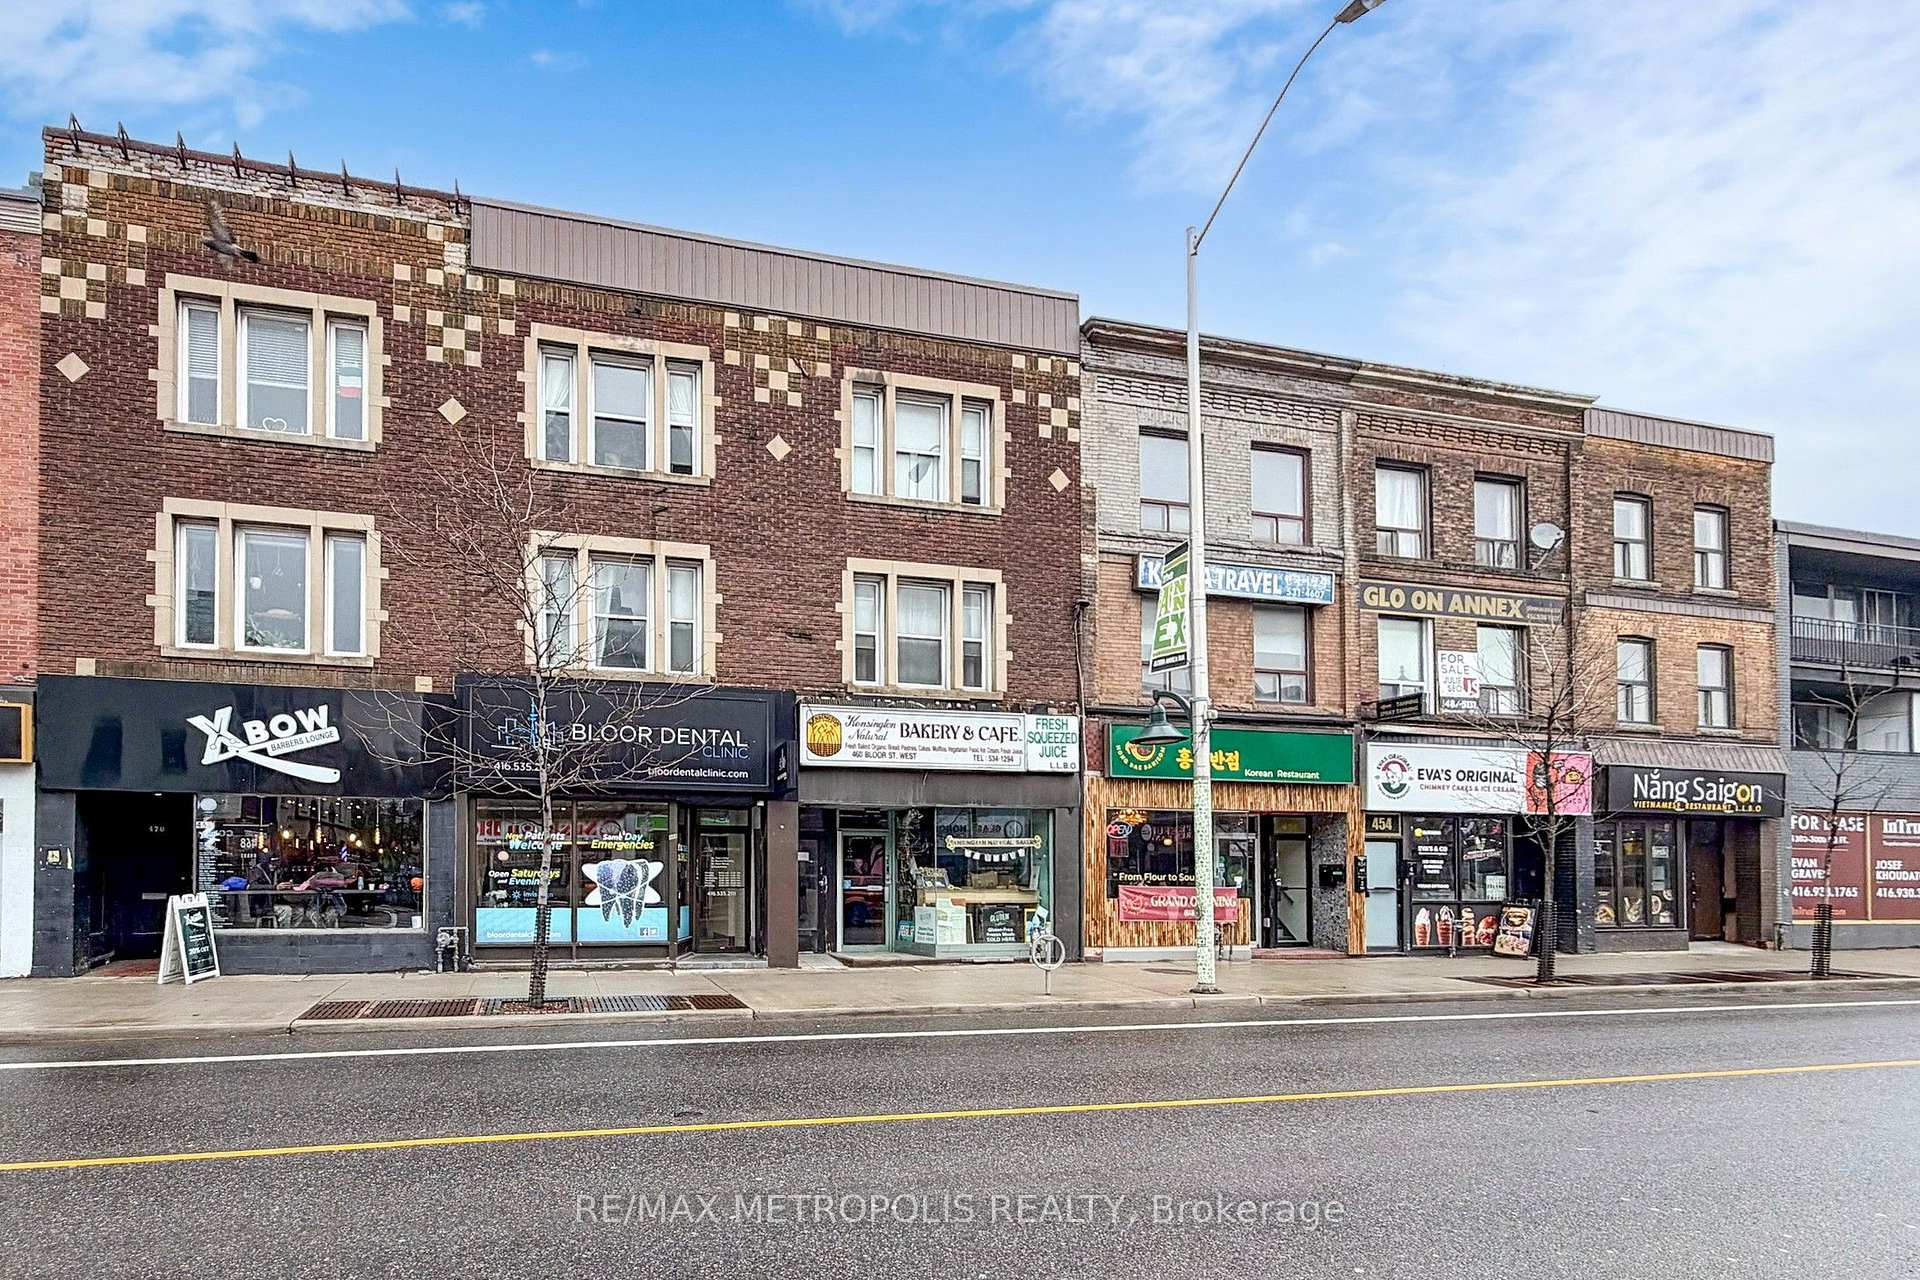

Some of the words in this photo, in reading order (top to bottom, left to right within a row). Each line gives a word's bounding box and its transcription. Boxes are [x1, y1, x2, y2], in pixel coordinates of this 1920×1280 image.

[1216, 568, 1280, 595] TRAVEL
[1363, 586, 1405, 608] GLO
[1411, 590, 1443, 612] ON
[1448, 593, 1524, 618] ANNEX
[1441, 653, 1464, 664] FOR
[1441, 665, 1469, 675] SALE
[1035, 717, 1069, 730] FRESH
[573, 723, 652, 744] BLOOR
[661, 727, 748, 747] DENTAL
[848, 728, 889, 741] Natural
[900, 722, 960, 740] BAKERY
[963, 726, 974, 741] &
[1027, 731, 1077, 744] SQUEEZED
[271, 737, 304, 752] BARBERS
[305, 730, 335, 744] LOUNGE
[702, 745, 749, 759] CLINIC
[865, 751, 887, 759] BLOOR
[900, 752, 917, 760] WEST
[1039, 745, 1068, 758] JUICE
[1176, 747, 1240, 771] 홍반점
[1245, 768, 1273, 778] Korean
[1277, 769, 1320, 779] Restaurant
[1417, 768, 1452, 781] EVA'S
[1455, 769, 1518, 784] ORIGINAL
[1419, 783, 1450, 791] CHIMNEY
[1452, 784, 1473, 792] CAKES
[1493, 785, 1516, 793] CREAM
[1693, 777, 1762, 813] Saigon
[1633, 800, 1682, 809] VIETNAMESE
[1685, 803, 1732, 812] RESTAURANT
[1371, 817, 1393, 831] 454
[1791, 815, 1819, 830] FOR
[524, 831, 566, 841] Patints
[1107, 823, 1132, 836] OPEN
[624, 832, 644, 842] Day
[591, 839, 655, 850] Emergencies
[1791, 858, 1818, 868] EVAN
[1875, 860, 1904, 869] JOSEF
[488, 870, 509, 879] Open
[1119, 873, 1142, 881] From
[1144, 873, 1166, 881] Flour
[1168, 873, 1177, 881] to
[1876, 870, 1920, 881] KHOUDAT
[508, 877, 551, 886] Evenins
[1150, 895, 1187, 907] GRAND
[1189, 895, 1237, 908] ONING
